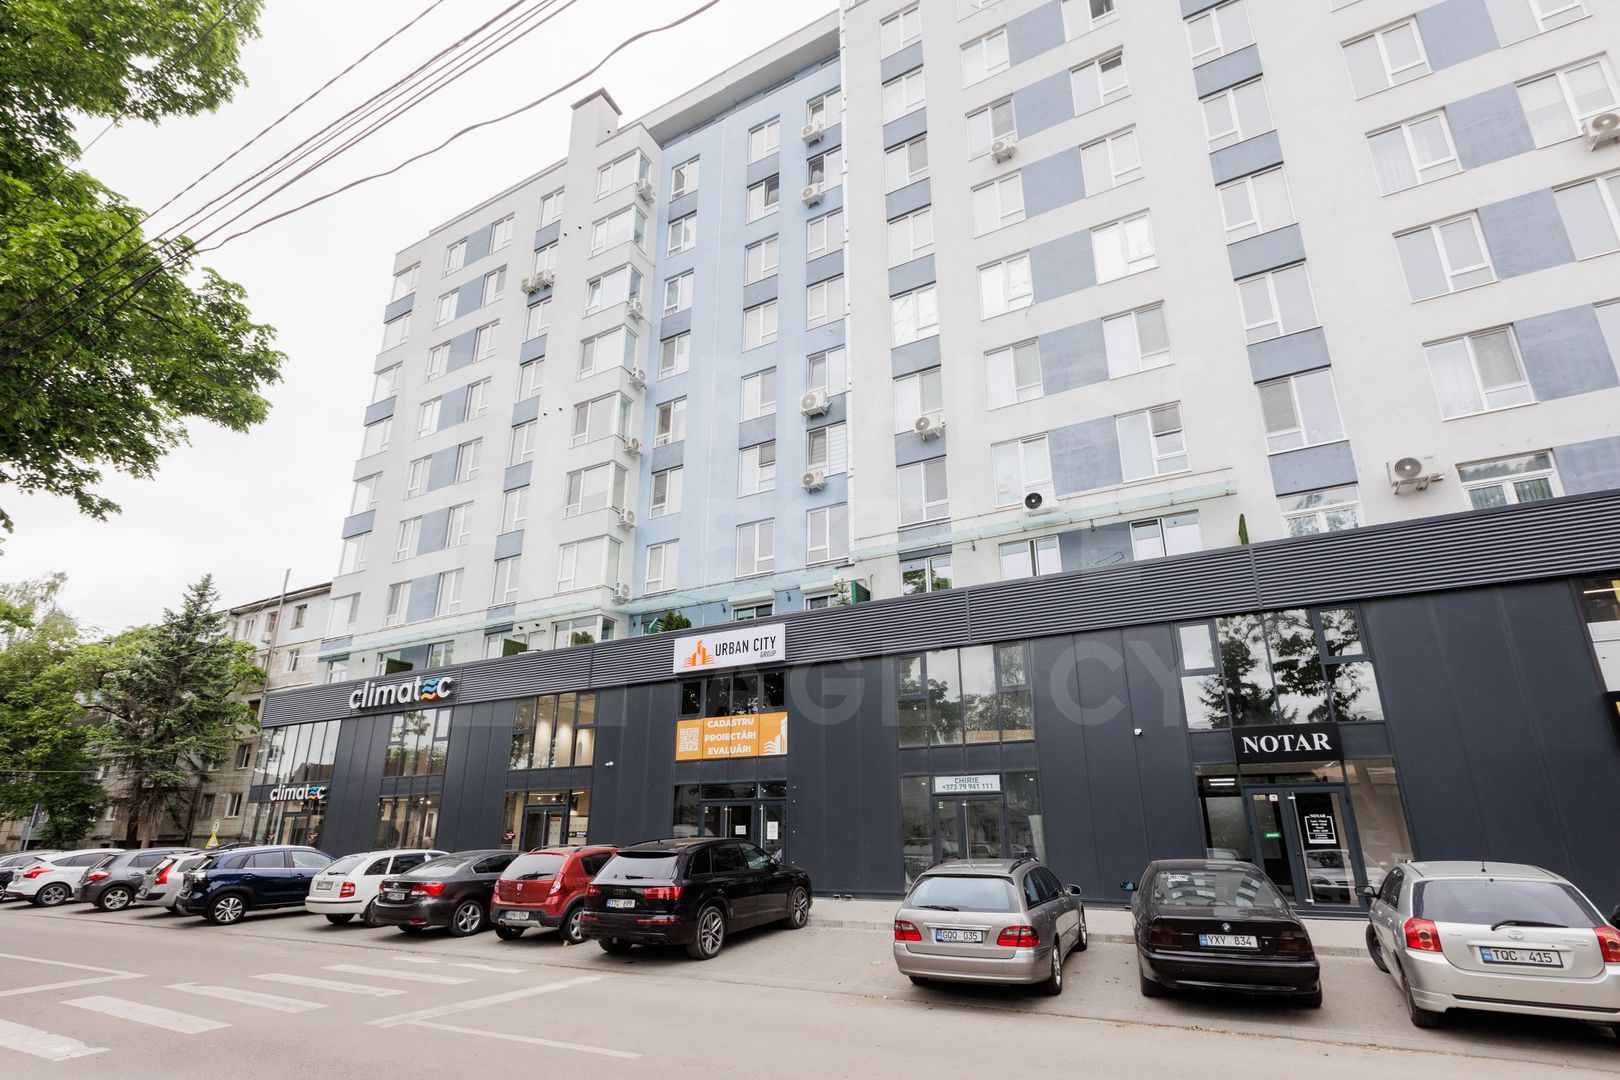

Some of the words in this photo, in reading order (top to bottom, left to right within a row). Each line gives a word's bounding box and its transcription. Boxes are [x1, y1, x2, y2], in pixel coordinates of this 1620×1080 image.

[715, 639, 749, 657] URBAN
[753, 635, 777, 652] CITY
[760, 650, 777, 658] GROUP
[707, 717, 754, 728] CADASTRU
[704, 731, 757, 742] PROIECTĂRI
[1242, 732, 1332, 754] NOTAR
[708, 744, 752, 755] EVALUĂRI
[963, 931, 978, 940] 035
[1207, 935, 1226, 944] YXY
[1234, 936, 1252, 945] 834
[1492, 949, 1518, 961] TQC
[1529, 951, 1553, 963] 415
